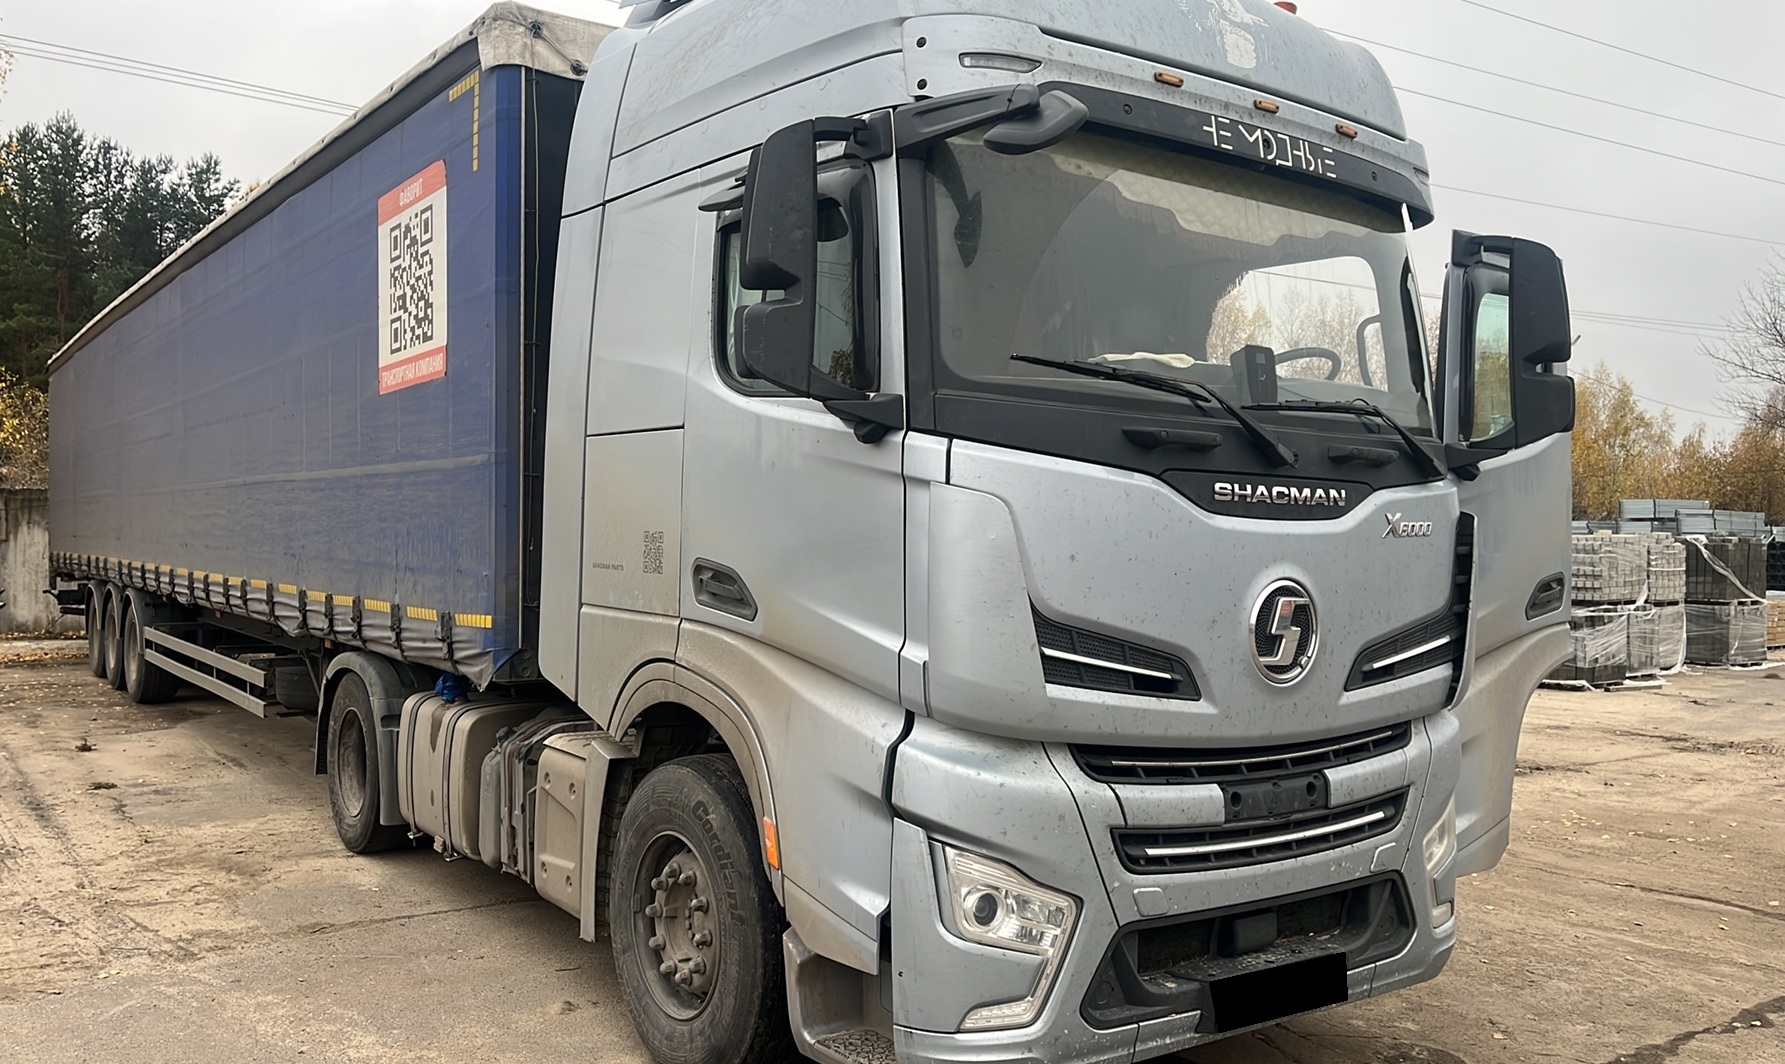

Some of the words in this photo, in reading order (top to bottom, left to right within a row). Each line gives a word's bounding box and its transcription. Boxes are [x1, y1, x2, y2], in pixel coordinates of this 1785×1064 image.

[399, 177, 423, 207] ФАВОРИТ
[381, 361, 416, 388] ТРАНСПОРТНАЯ
[416, 353, 443, 377] КОМПАНИЯ
[1213, 482, 1346, 507] SHACMAN
[1381, 512, 1433, 539] X6000
[691, 800, 747, 930] Cordiant
